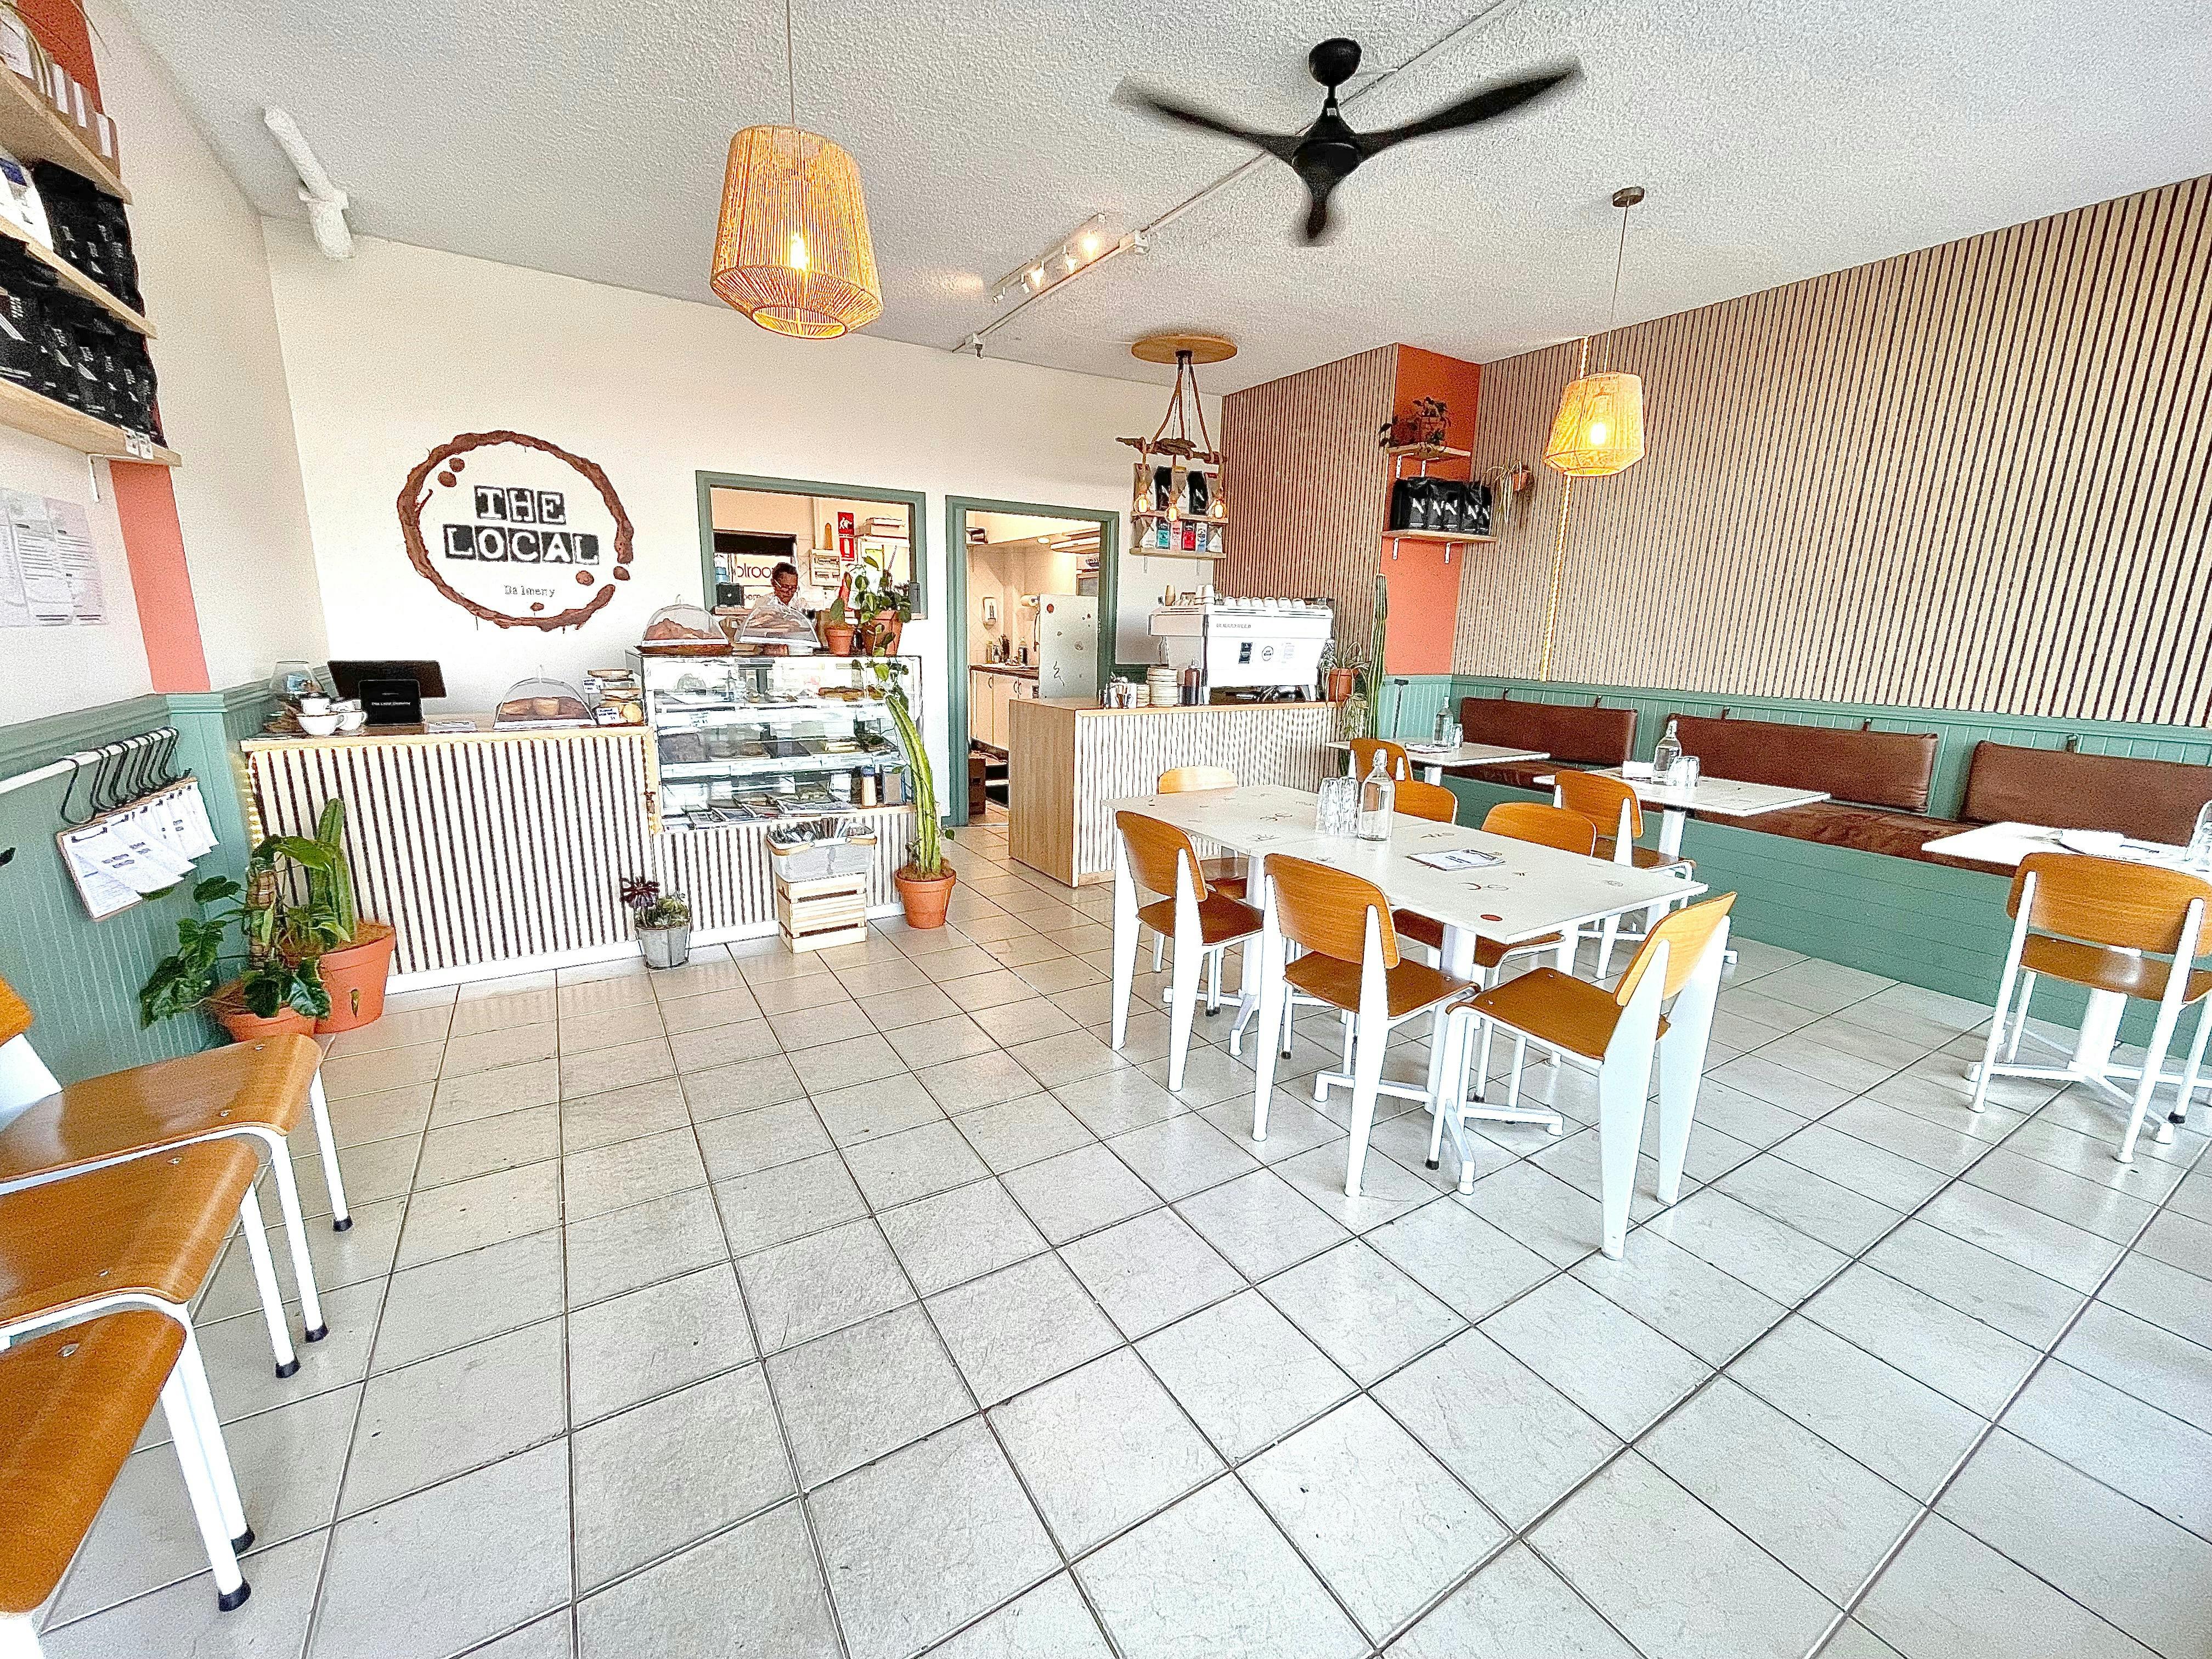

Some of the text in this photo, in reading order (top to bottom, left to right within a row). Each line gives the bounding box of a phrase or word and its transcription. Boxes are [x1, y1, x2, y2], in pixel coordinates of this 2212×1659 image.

[474, 486, 566, 525] THE
[443, 524, 600, 565] LOCAL
[737, 563, 773, 578] olroo
[504, 585, 555, 597] Dalmeny
